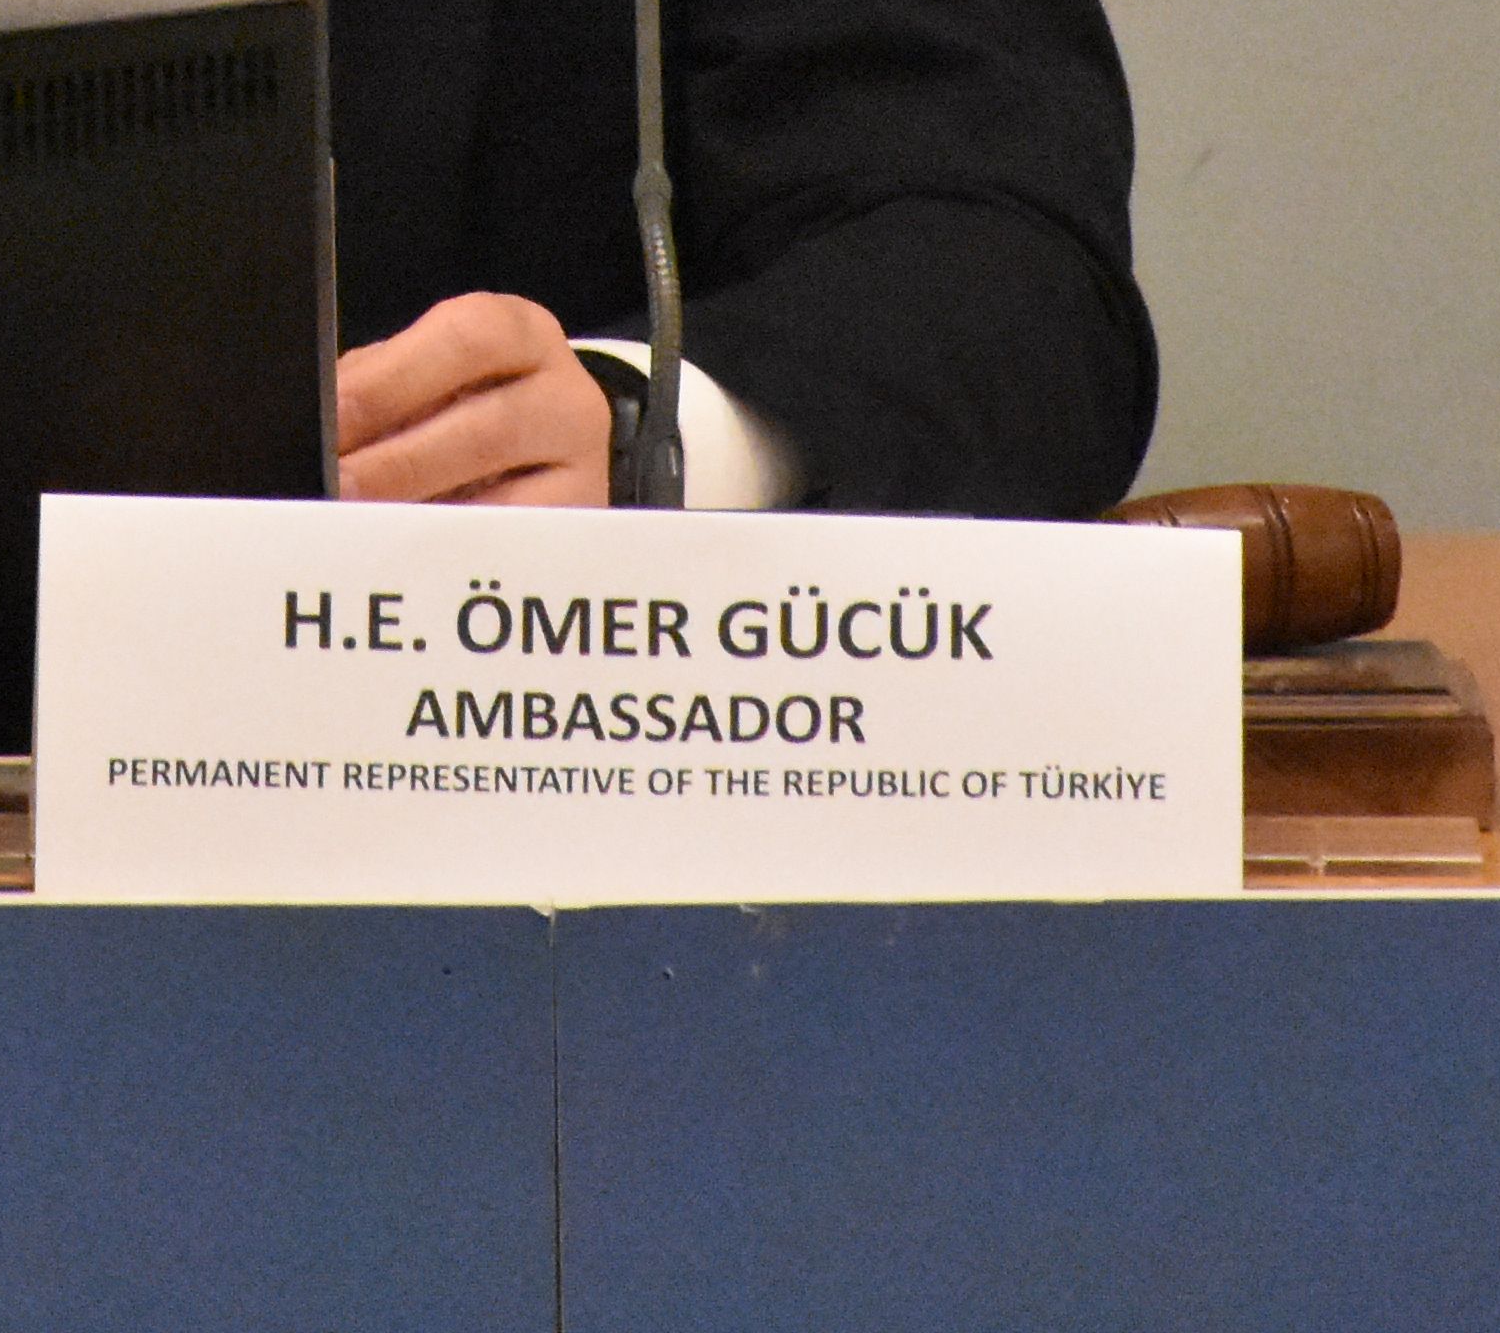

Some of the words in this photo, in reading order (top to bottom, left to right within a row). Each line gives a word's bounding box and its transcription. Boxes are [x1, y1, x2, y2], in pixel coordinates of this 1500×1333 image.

[284, 590, 427, 653] H.E.
[456, 578, 691, 658] ÖMER
[717, 585, 993, 661] GÜCÜK
[405, 688, 866, 745] AMBASSADOR
[107, 757, 331, 790] PERMANENT
[342, 761, 634, 795] REPRESENTATIVE
[646, 767, 692, 796] OF
[705, 768, 769, 797] THE
[782, 769, 949, 799] REPUBLIC
[960, 770, 1006, 799] OF
[1019, 765, 1164, 801] TÜRKİYE
